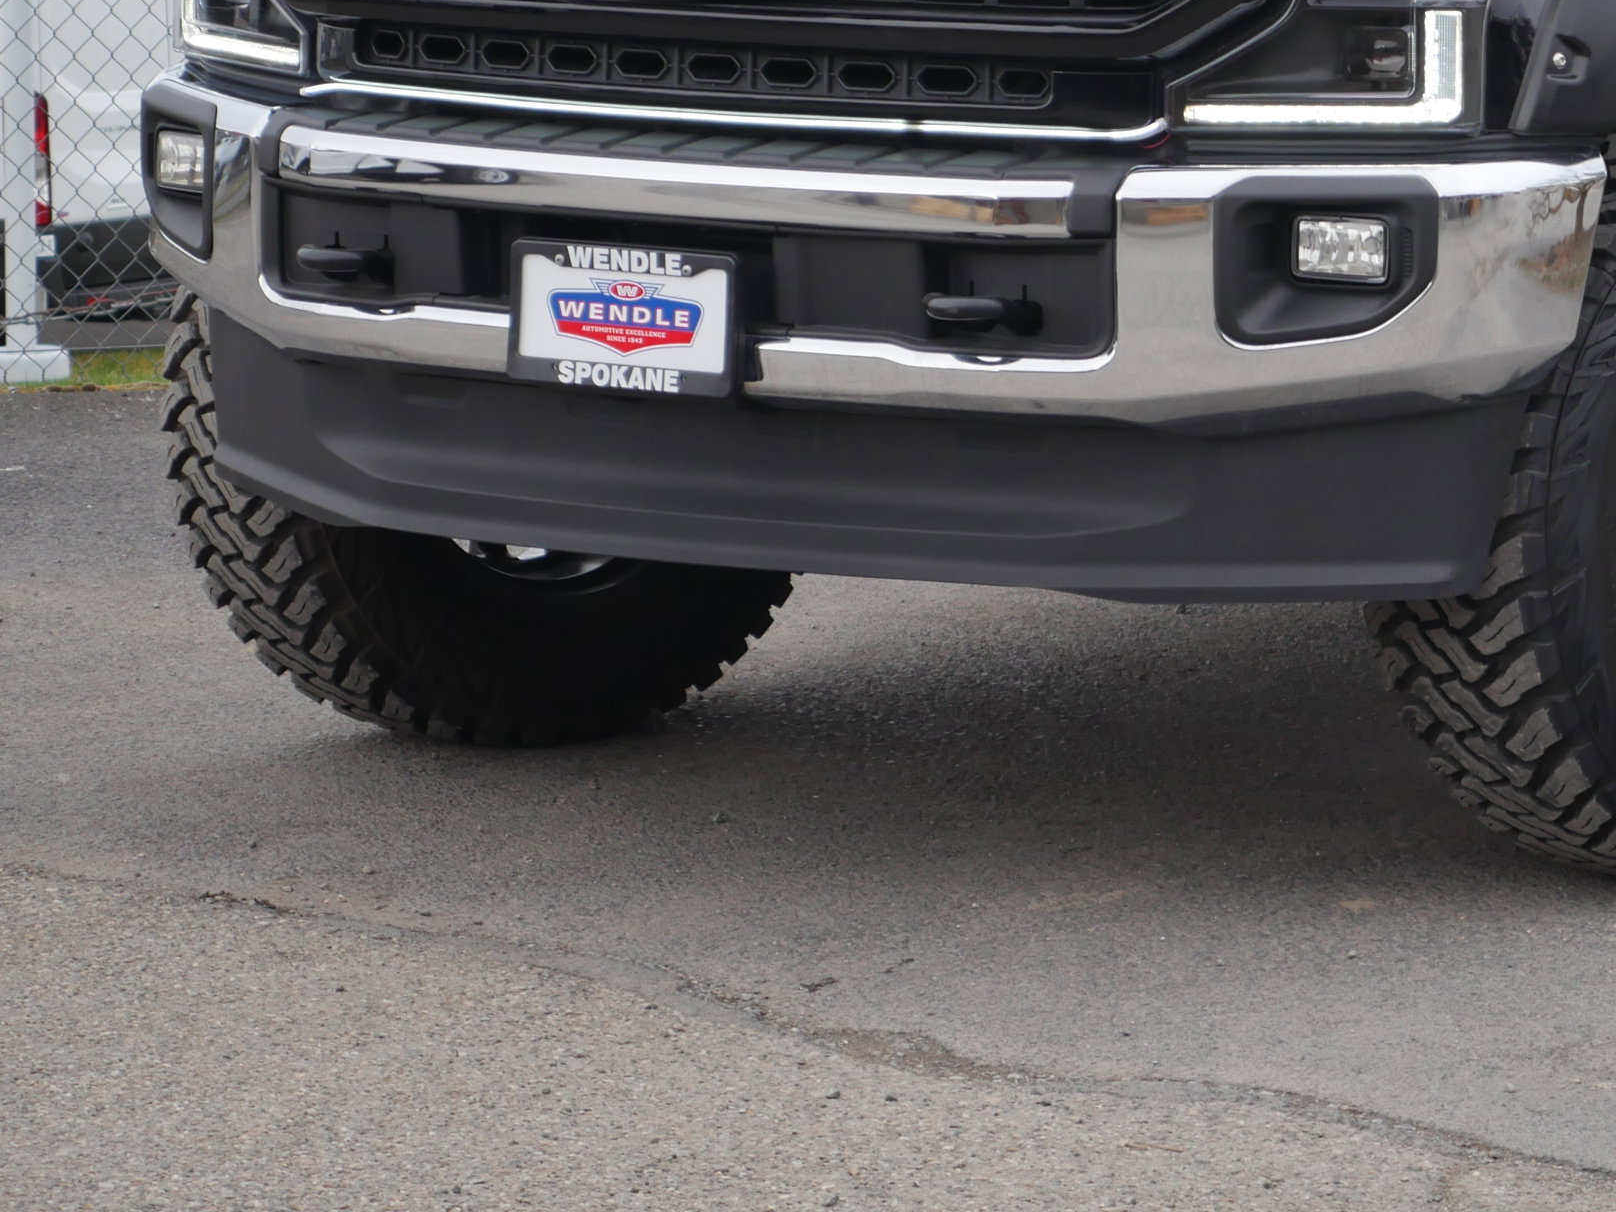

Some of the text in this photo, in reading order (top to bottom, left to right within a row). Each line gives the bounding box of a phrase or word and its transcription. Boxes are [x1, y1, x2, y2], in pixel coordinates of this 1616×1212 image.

[567, 246, 682, 276] WENDLE
[558, 300, 690, 328] WENDLE
[582, 325, 667, 338] AUTOMOTIVE EXCELLENCE
[606, 335, 627, 343] SINCE
[557, 360, 680, 393] SPOKANE
